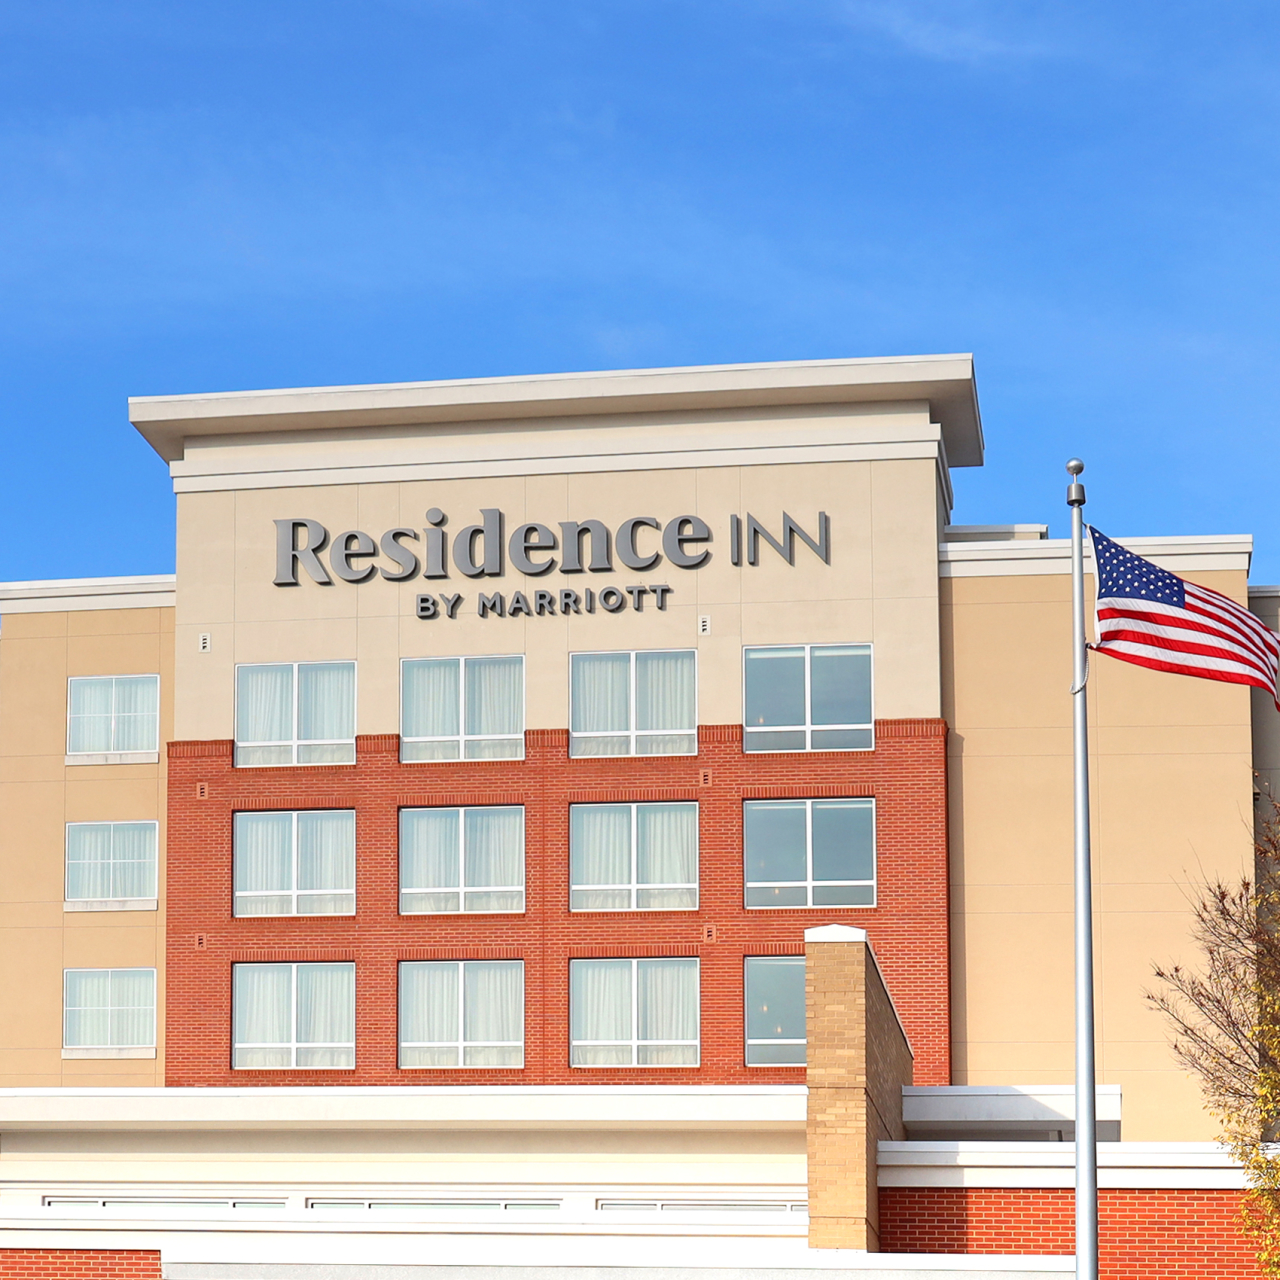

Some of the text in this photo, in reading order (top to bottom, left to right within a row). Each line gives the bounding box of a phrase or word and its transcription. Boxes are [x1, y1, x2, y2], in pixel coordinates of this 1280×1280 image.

[273, 508, 831, 588] Residence INN
[415, 585, 675, 620] BY MARRIOTT
